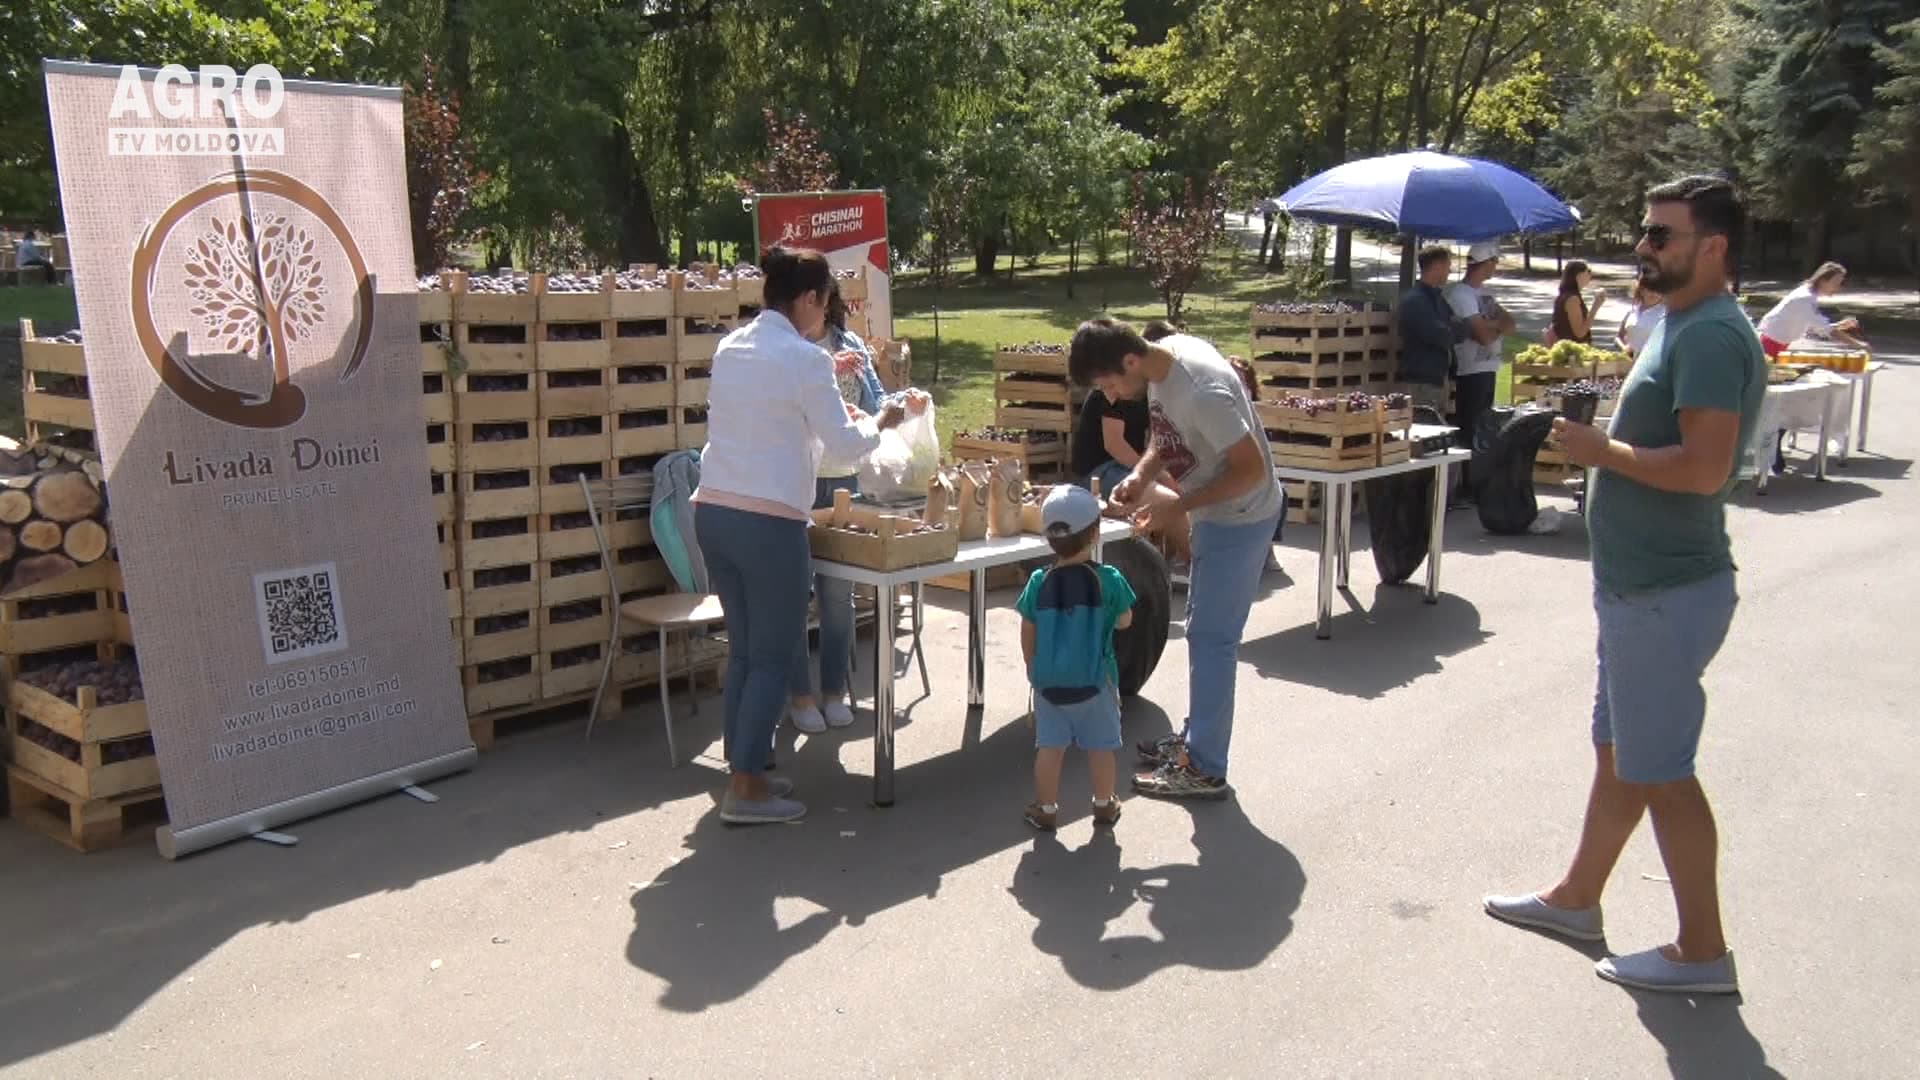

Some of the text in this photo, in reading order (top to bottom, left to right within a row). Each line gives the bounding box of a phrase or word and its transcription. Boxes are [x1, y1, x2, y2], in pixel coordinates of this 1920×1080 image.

[811, 205, 863, 226] CHISINAU
[811, 219, 863, 239] MARATHON
[162, 437, 380, 485] Livada Doinei
[223, 482, 337, 507] PRUNE USCATE
[213, 699, 417, 761] livadadoinei@gmail.com
